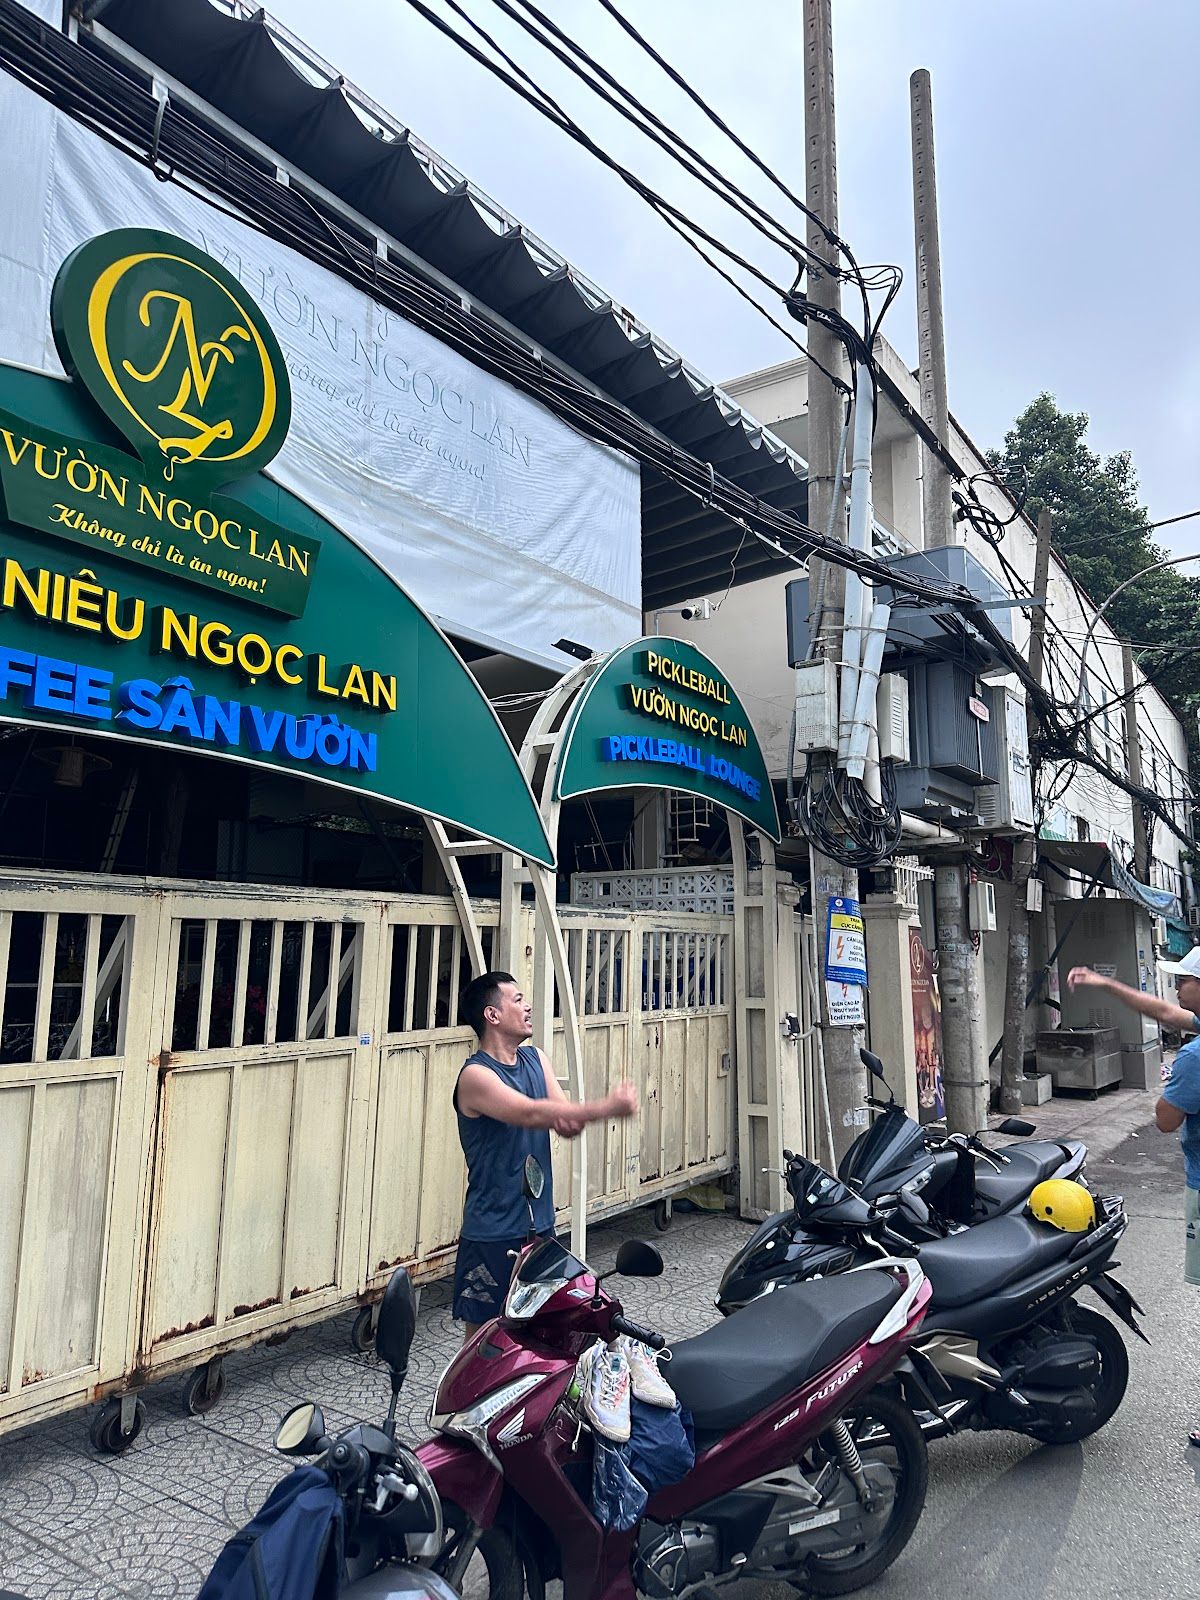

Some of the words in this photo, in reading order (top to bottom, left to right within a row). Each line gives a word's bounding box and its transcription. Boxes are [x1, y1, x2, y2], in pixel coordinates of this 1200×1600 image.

[469, 400, 533, 468] LAN
[0, 428, 129, 507] VƯỜN
[137, 483, 243, 550] NGỌC
[248, 528, 311, 578] LAN
[48, 503, 128, 548] Không
[131, 537, 161, 558] chỉ
[165, 544, 186, 566] là
[189, 555, 214, 577] ăn
[216, 567, 267, 595] ngon!
[3, 558, 145, 641] NIÊU
[160, 605, 304, 685] NGỌC
[317, 653, 398, 712] LAN
[0, 645, 114, 720] FEE
[117, 675, 241, 747] SÂN
[245, 703, 378, 773] VƯỜN
[647, 650, 731, 705] PICKLEBALL
[630, 684, 676, 722] VƯỜN
[679, 705, 718, 738] NGỌC
[721, 720, 747, 747] LAN
[609, 735, 706, 773] PICKLEBALL
[710, 754, 762, 801] LOUNGE
[499, 1432, 534, 1451] HONDA
